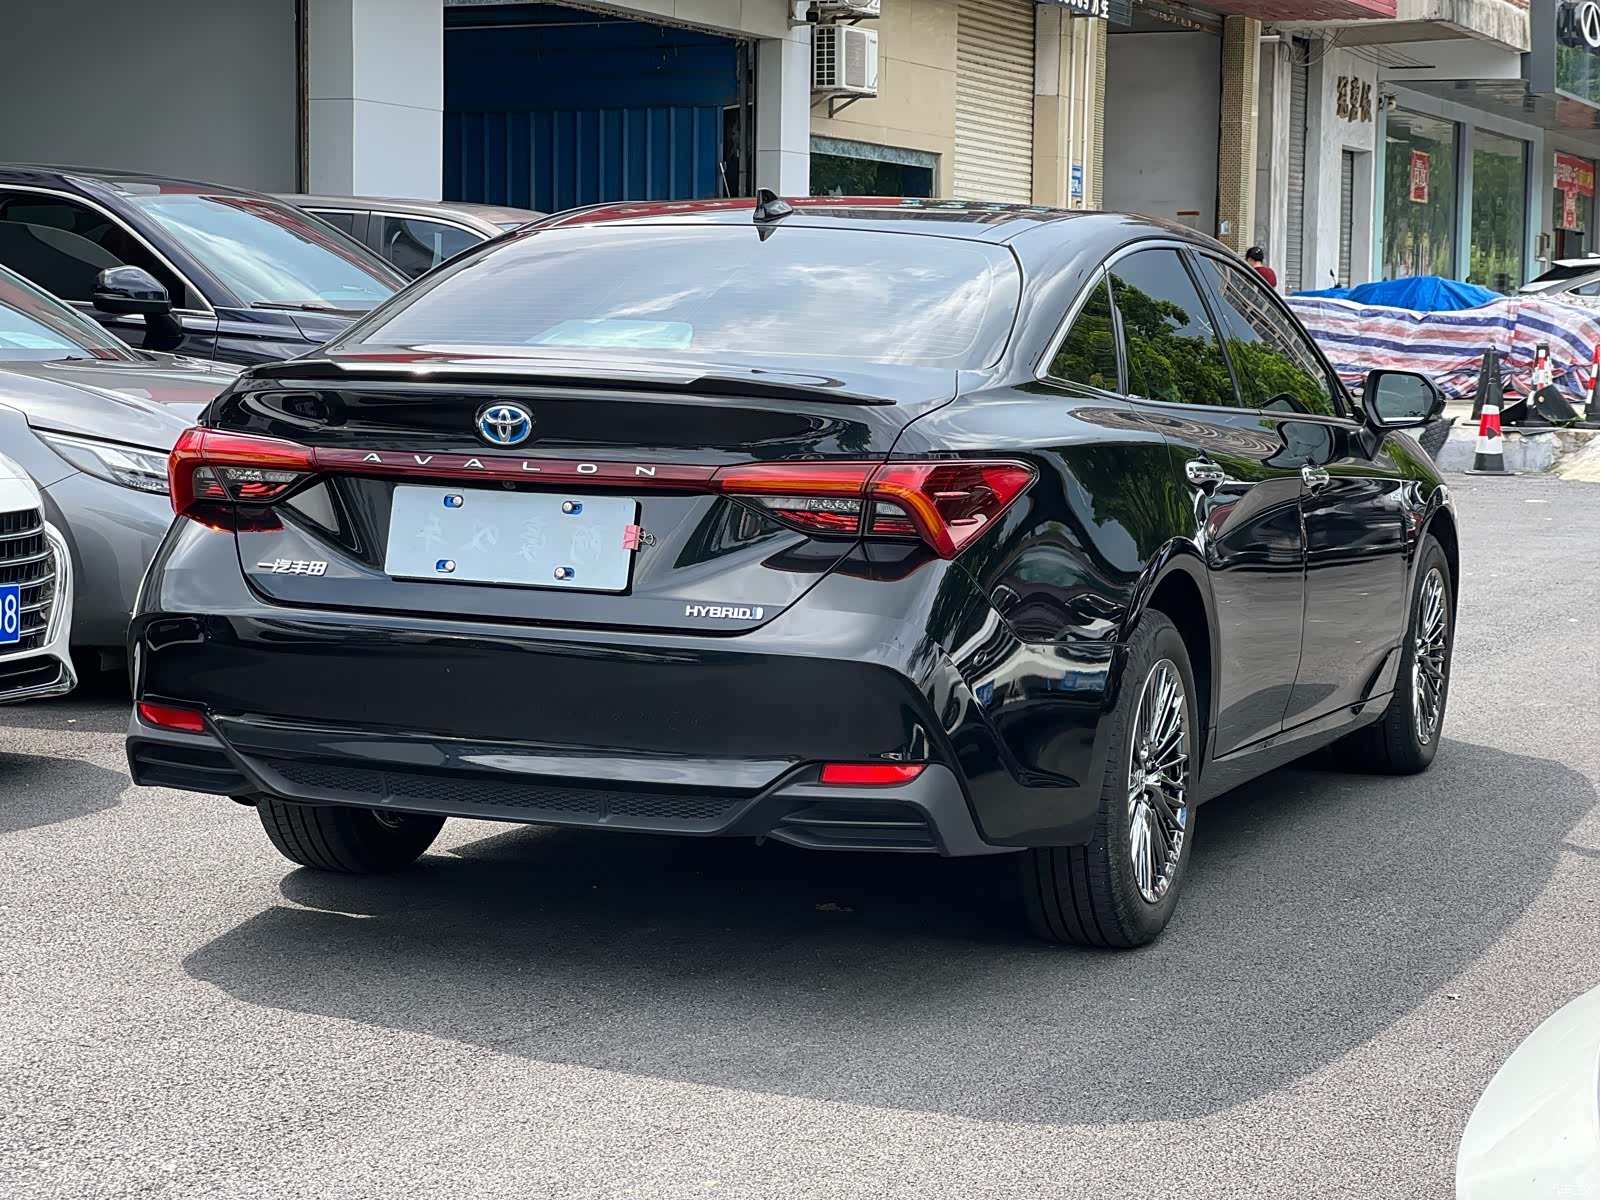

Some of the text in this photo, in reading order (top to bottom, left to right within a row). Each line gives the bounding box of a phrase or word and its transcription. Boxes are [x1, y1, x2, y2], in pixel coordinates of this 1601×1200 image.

[362, 452, 656, 476] AVALON
[257, 559, 328, 576] 一汽丰田
[685, 604, 751, 620] HYBRID
